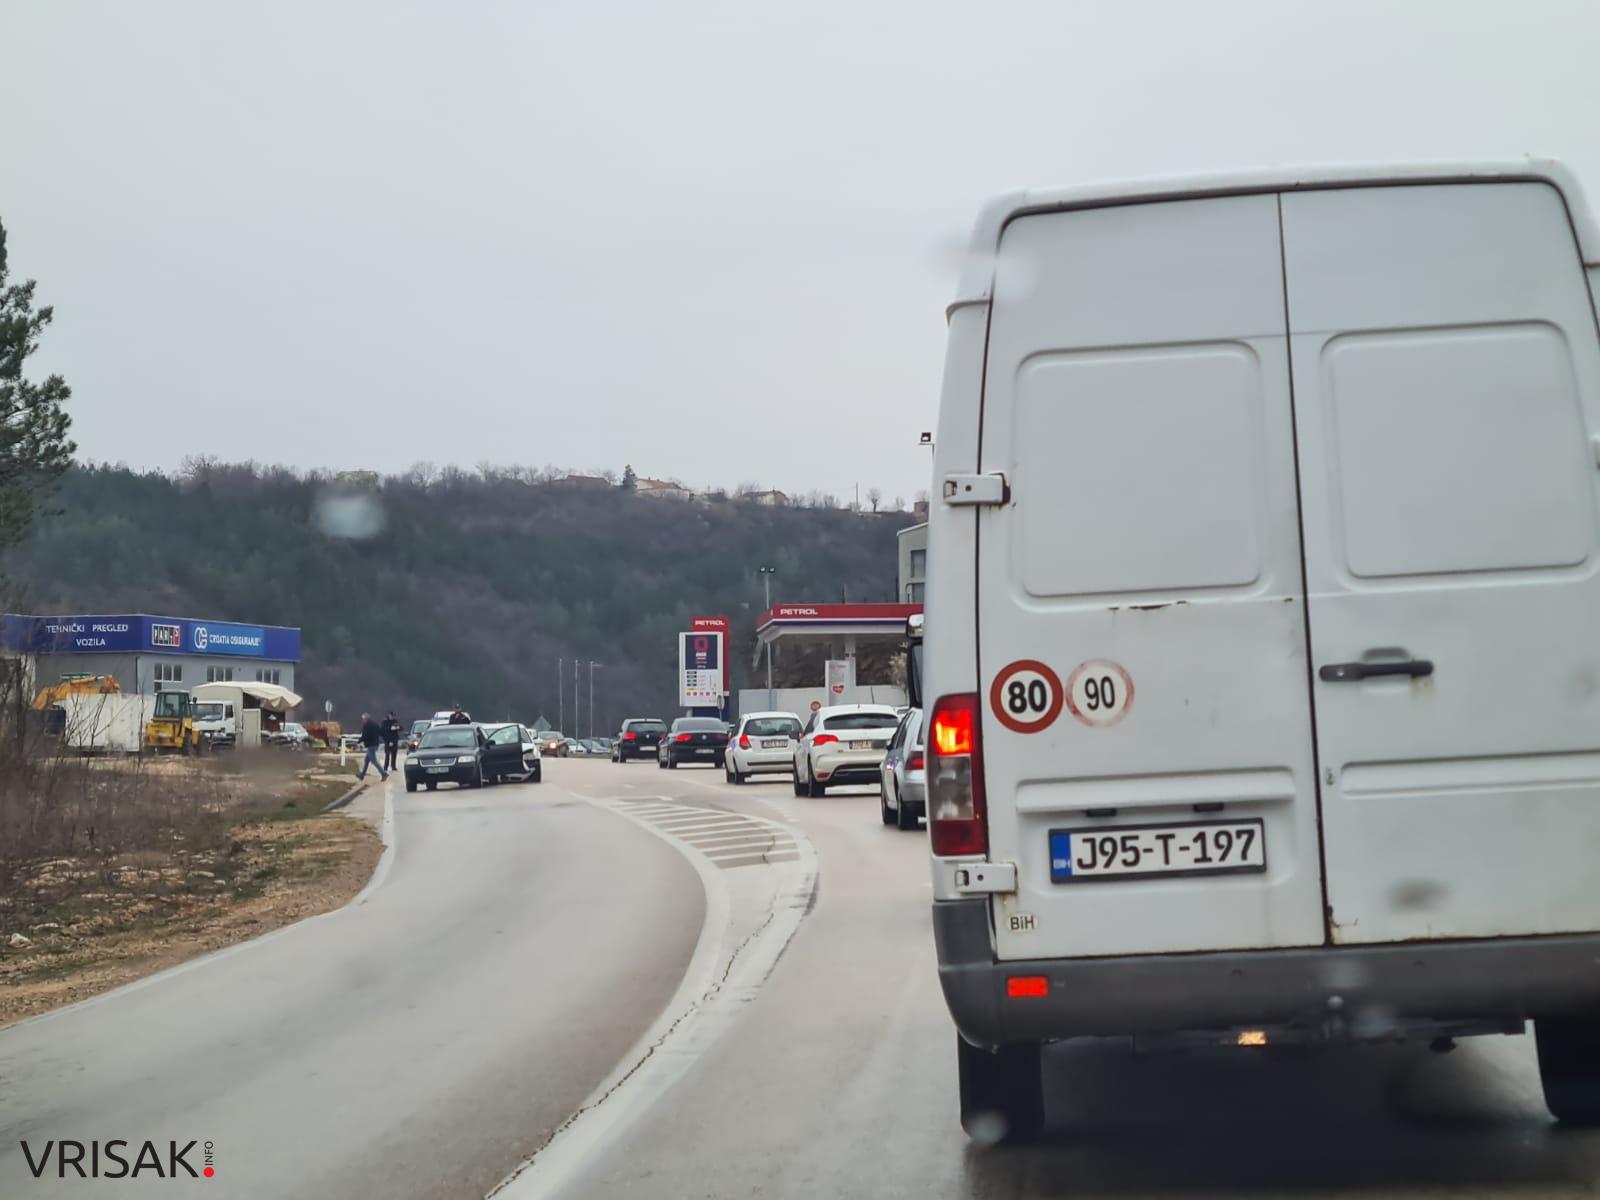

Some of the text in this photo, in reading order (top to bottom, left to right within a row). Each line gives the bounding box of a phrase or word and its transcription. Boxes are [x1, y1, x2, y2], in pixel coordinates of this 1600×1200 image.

[92, 624, 129, 632] PREGLED
[76, 638, 106, 646] VOZILA
[209, 634, 229, 645] CROATIA
[1008, 679, 1047, 714] 80
[1084, 676, 1115, 711] 90
[1077, 829, 1256, 870] J95-T-197
[1010, 915, 1034, 930] BiH
